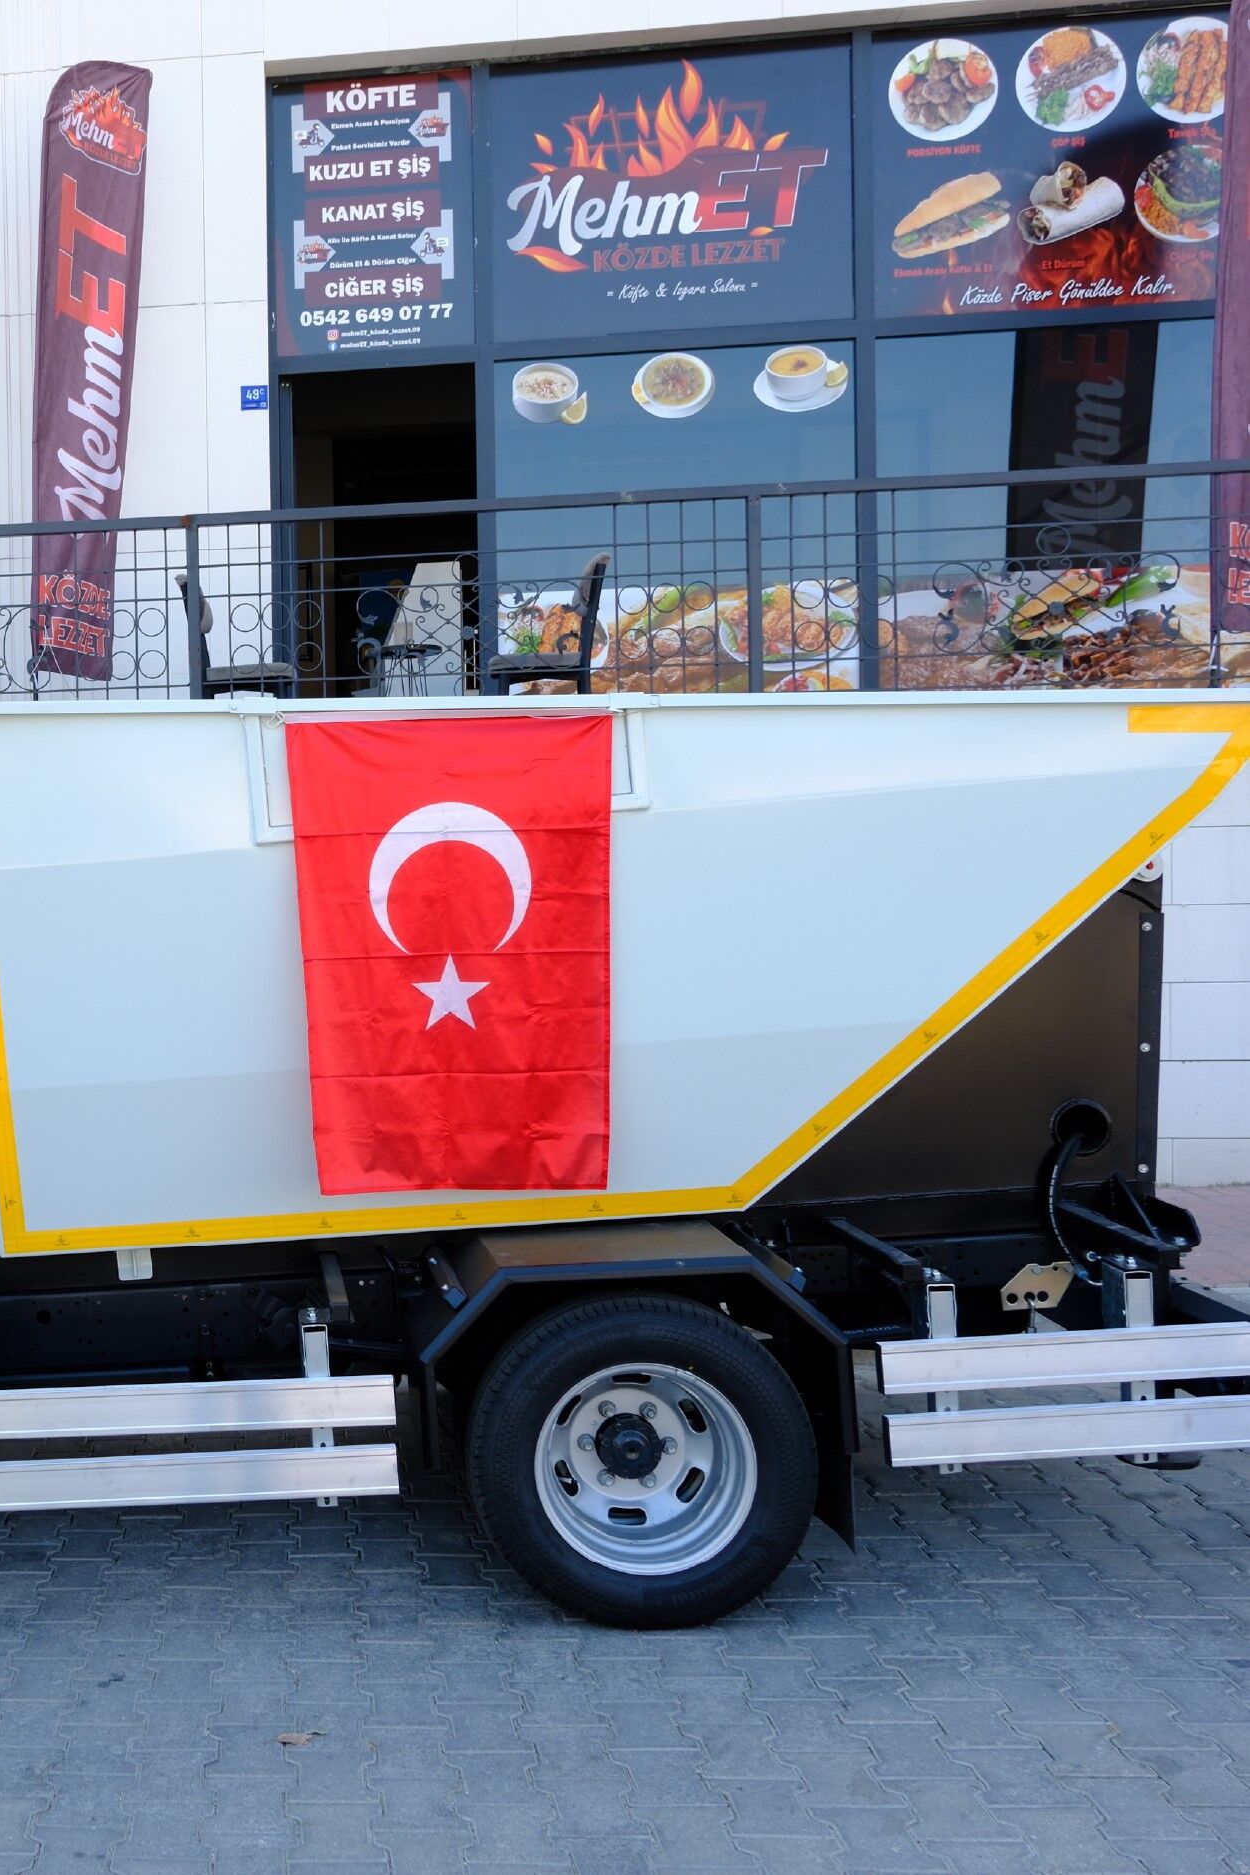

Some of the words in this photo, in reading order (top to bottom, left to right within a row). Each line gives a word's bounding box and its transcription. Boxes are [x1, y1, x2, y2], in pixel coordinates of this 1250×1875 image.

[326, 83, 416, 113] KÖFTE
[309, 164, 364, 182] KUZU
[370, 160, 394, 177] ET
[397, 153, 431, 179] ŞİŞ
[321, 202, 387, 224] KANAT
[391, 197, 425, 223] ŞİŞ
[506, 147, 829, 256] MehmET
[593, 243, 687, 272] KÖZDE
[691, 237, 785, 266] LEZZET
[325, 274, 386, 298] CİĞER
[391, 273, 425, 299] ŞİŞ
[618, 284, 650, 304] Köfte
[655, 282, 668, 298] &
[710, 278, 746, 294] Salonu
[960, 285, 1003, 306] Közde
[1010, 281, 1054, 305] Pişer
[300, 308, 350, 327] 0542
[355, 306, 394, 324] 649
[399, 305, 423, 322] 07
[429, 302, 454, 319] 77
[38, 569, 111, 620] KÖZDE
[38, 614, 111, 657] LEZZET
